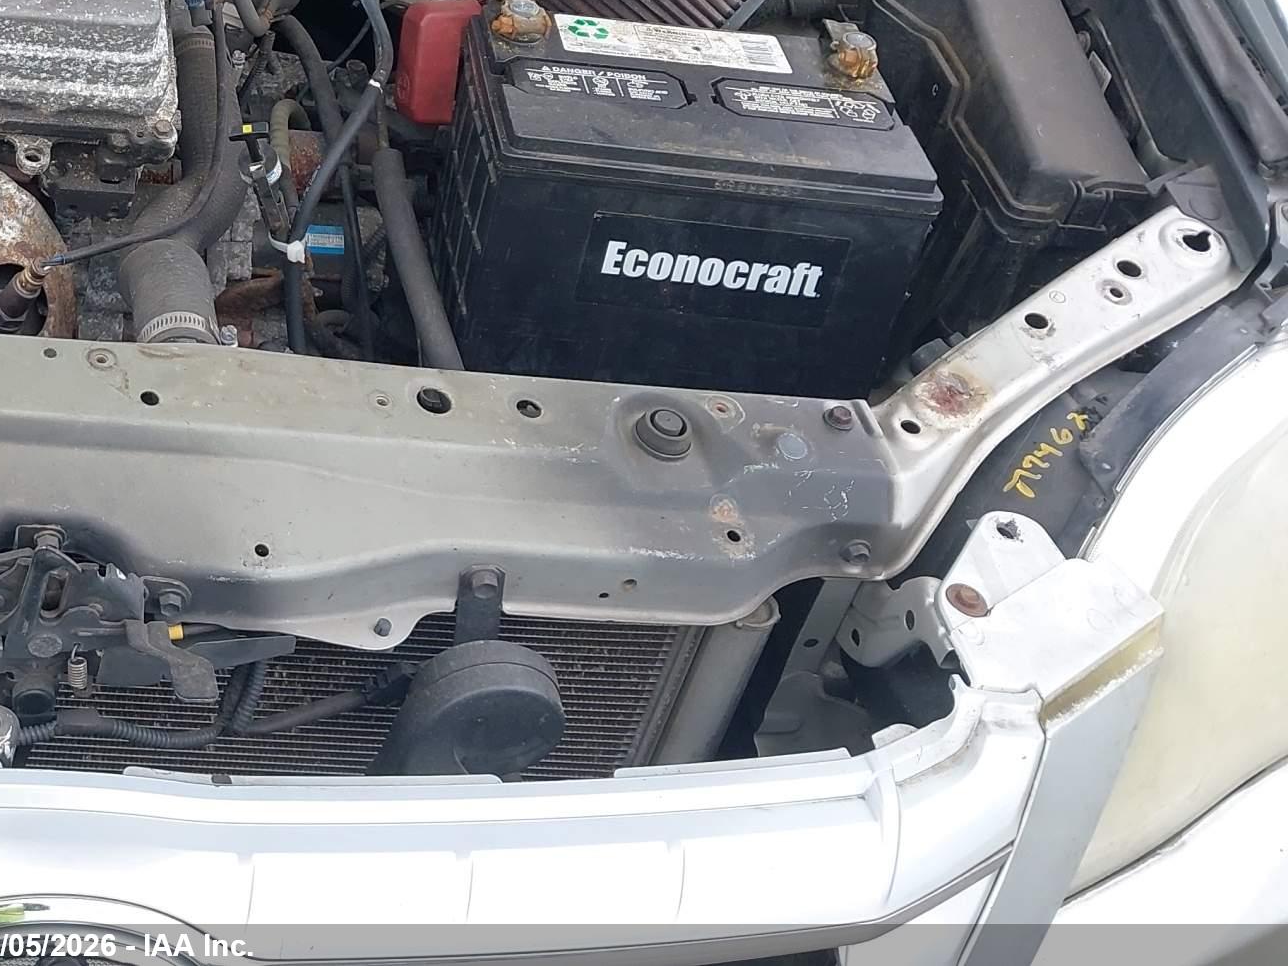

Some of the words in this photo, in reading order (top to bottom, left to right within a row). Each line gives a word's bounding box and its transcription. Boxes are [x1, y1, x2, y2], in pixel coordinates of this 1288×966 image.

[552, 66, 597, 77] DANGER
[607, 71, 647, 81] POISON
[600, 240, 824, 298] Econocraft
